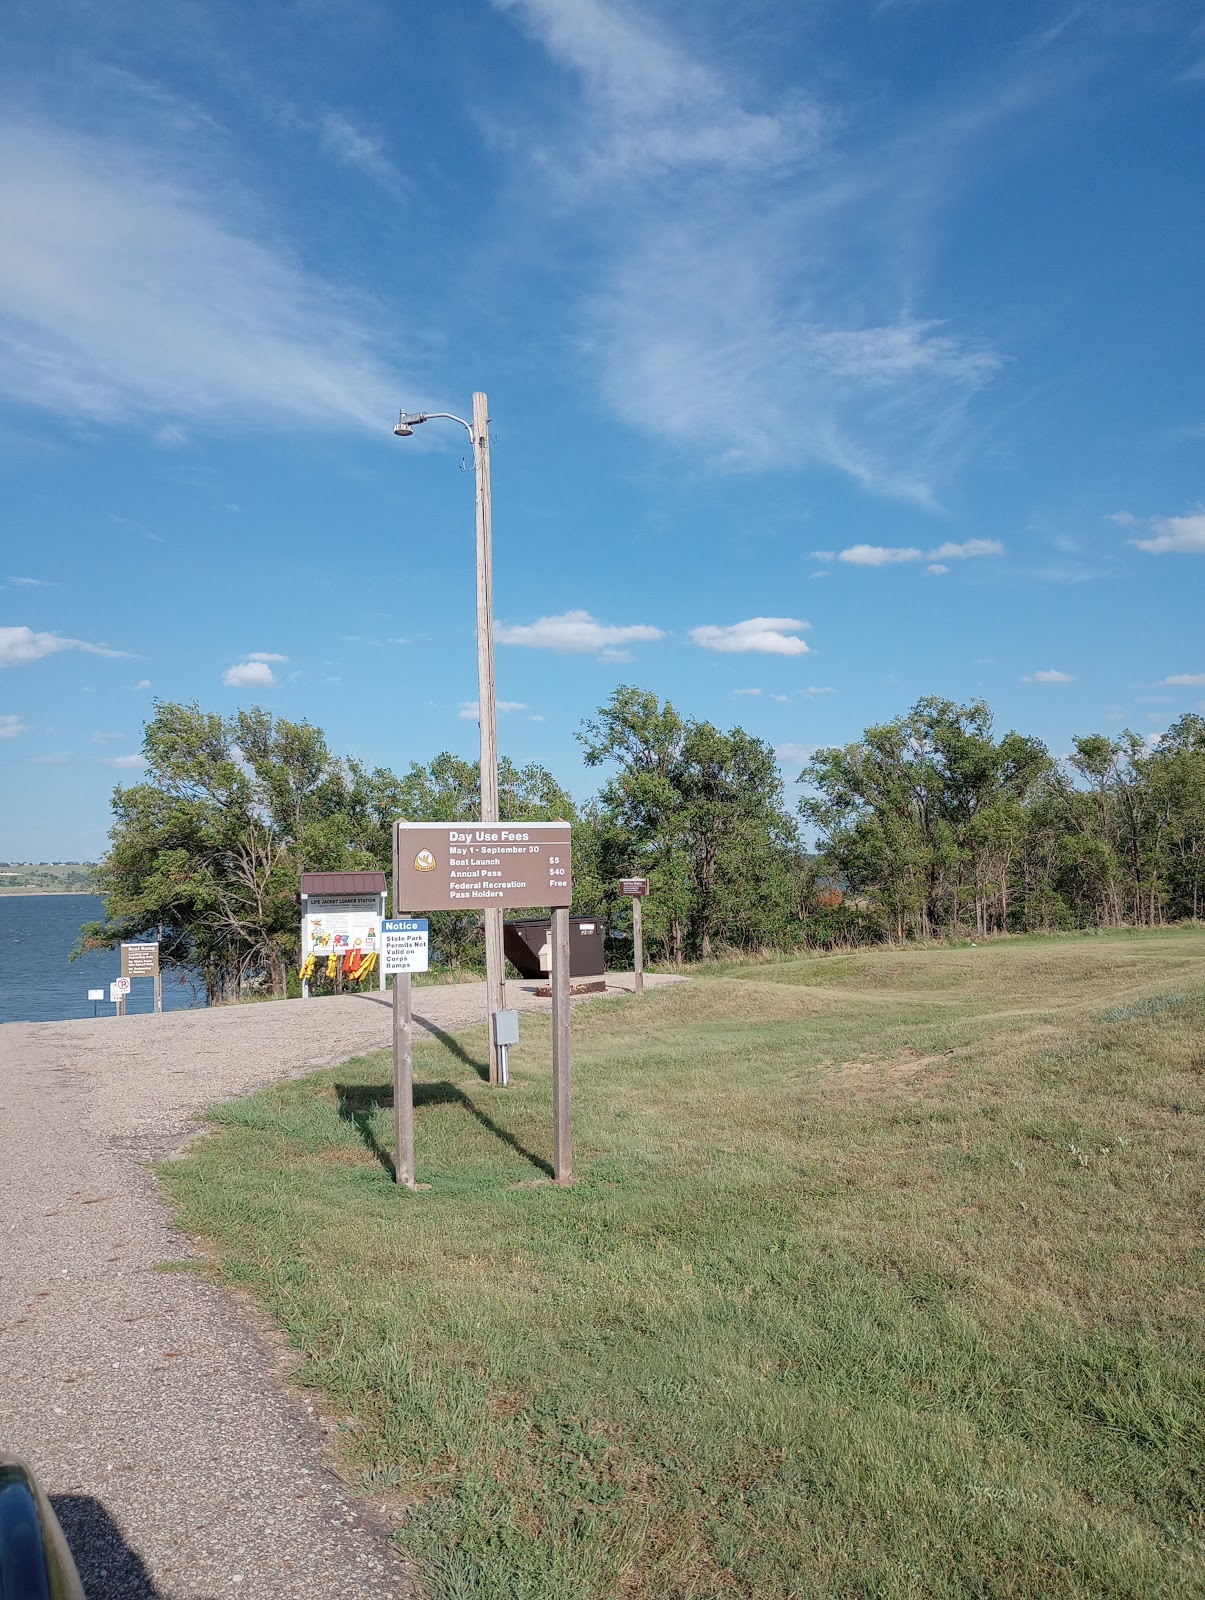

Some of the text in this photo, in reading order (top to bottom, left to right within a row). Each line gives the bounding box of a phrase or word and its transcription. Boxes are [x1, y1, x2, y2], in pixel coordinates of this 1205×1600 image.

[449, 832, 529, 843] Day Use Fees
[450, 847, 467, 855] May
[549, 868, 564, 876] $40
[386, 922, 418, 930] Notice
